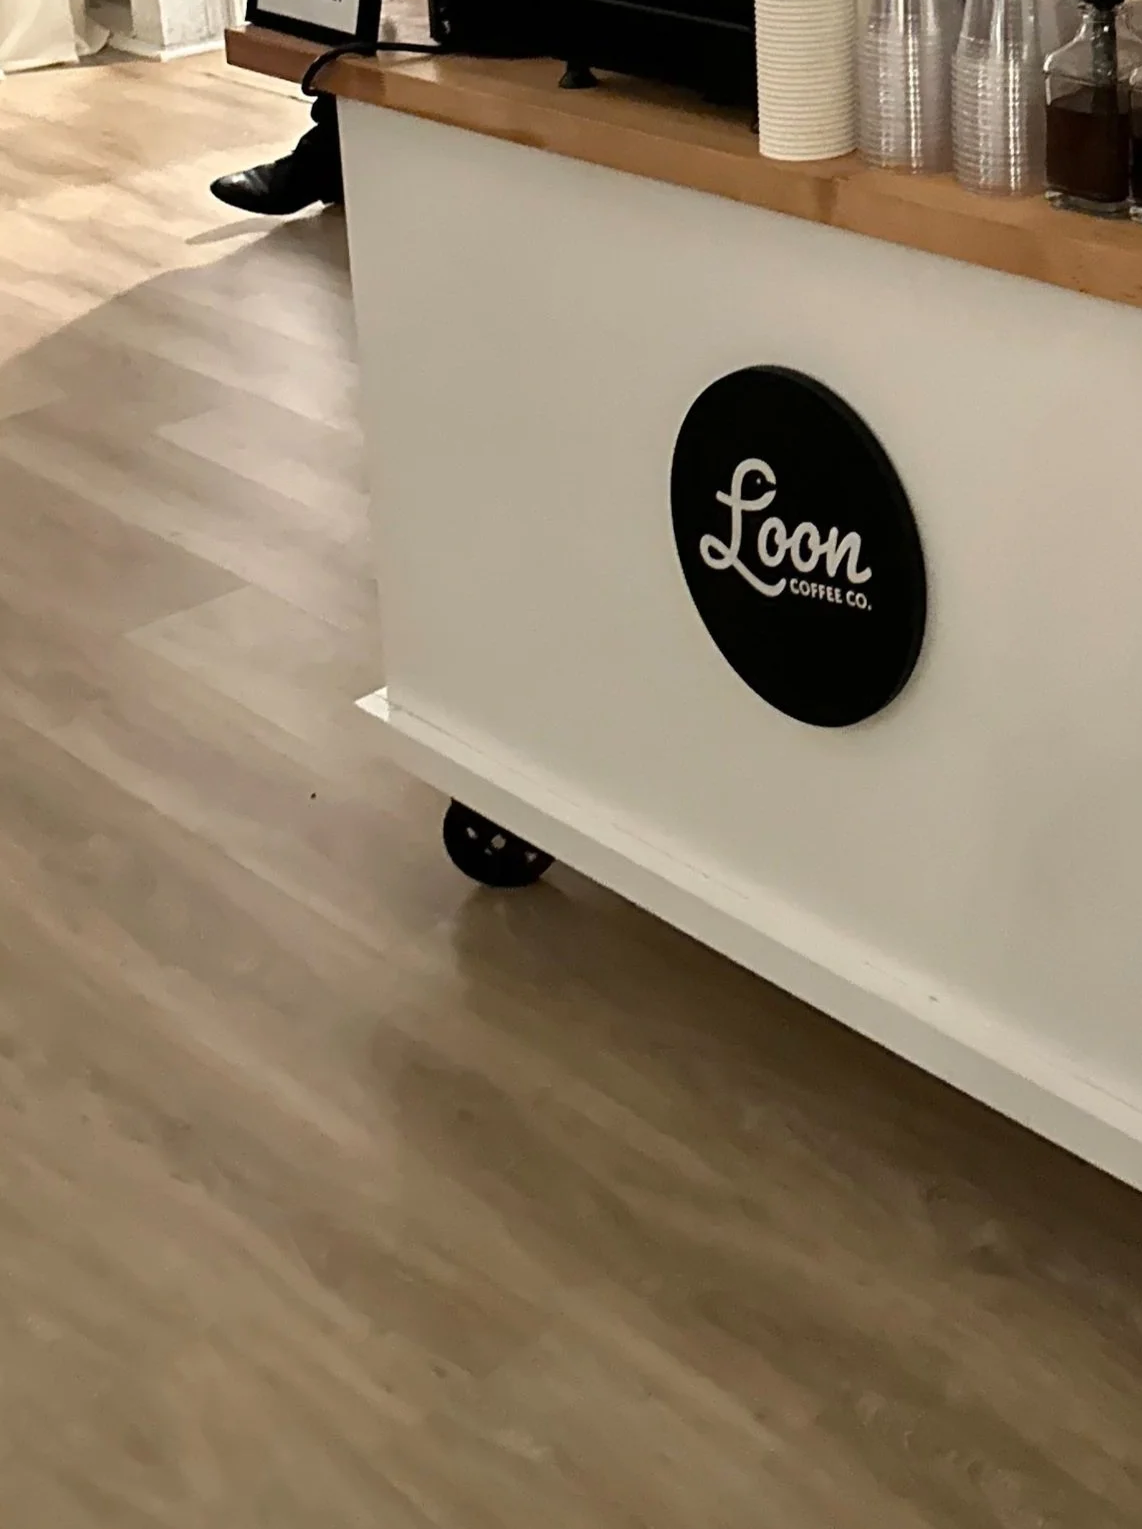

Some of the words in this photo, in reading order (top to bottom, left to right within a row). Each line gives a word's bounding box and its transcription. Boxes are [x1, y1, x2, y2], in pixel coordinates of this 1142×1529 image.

[700, 458, 872, 597] Loon
[789, 578, 843, 604] COFFEE
[845, 590, 873, 611] CO.
